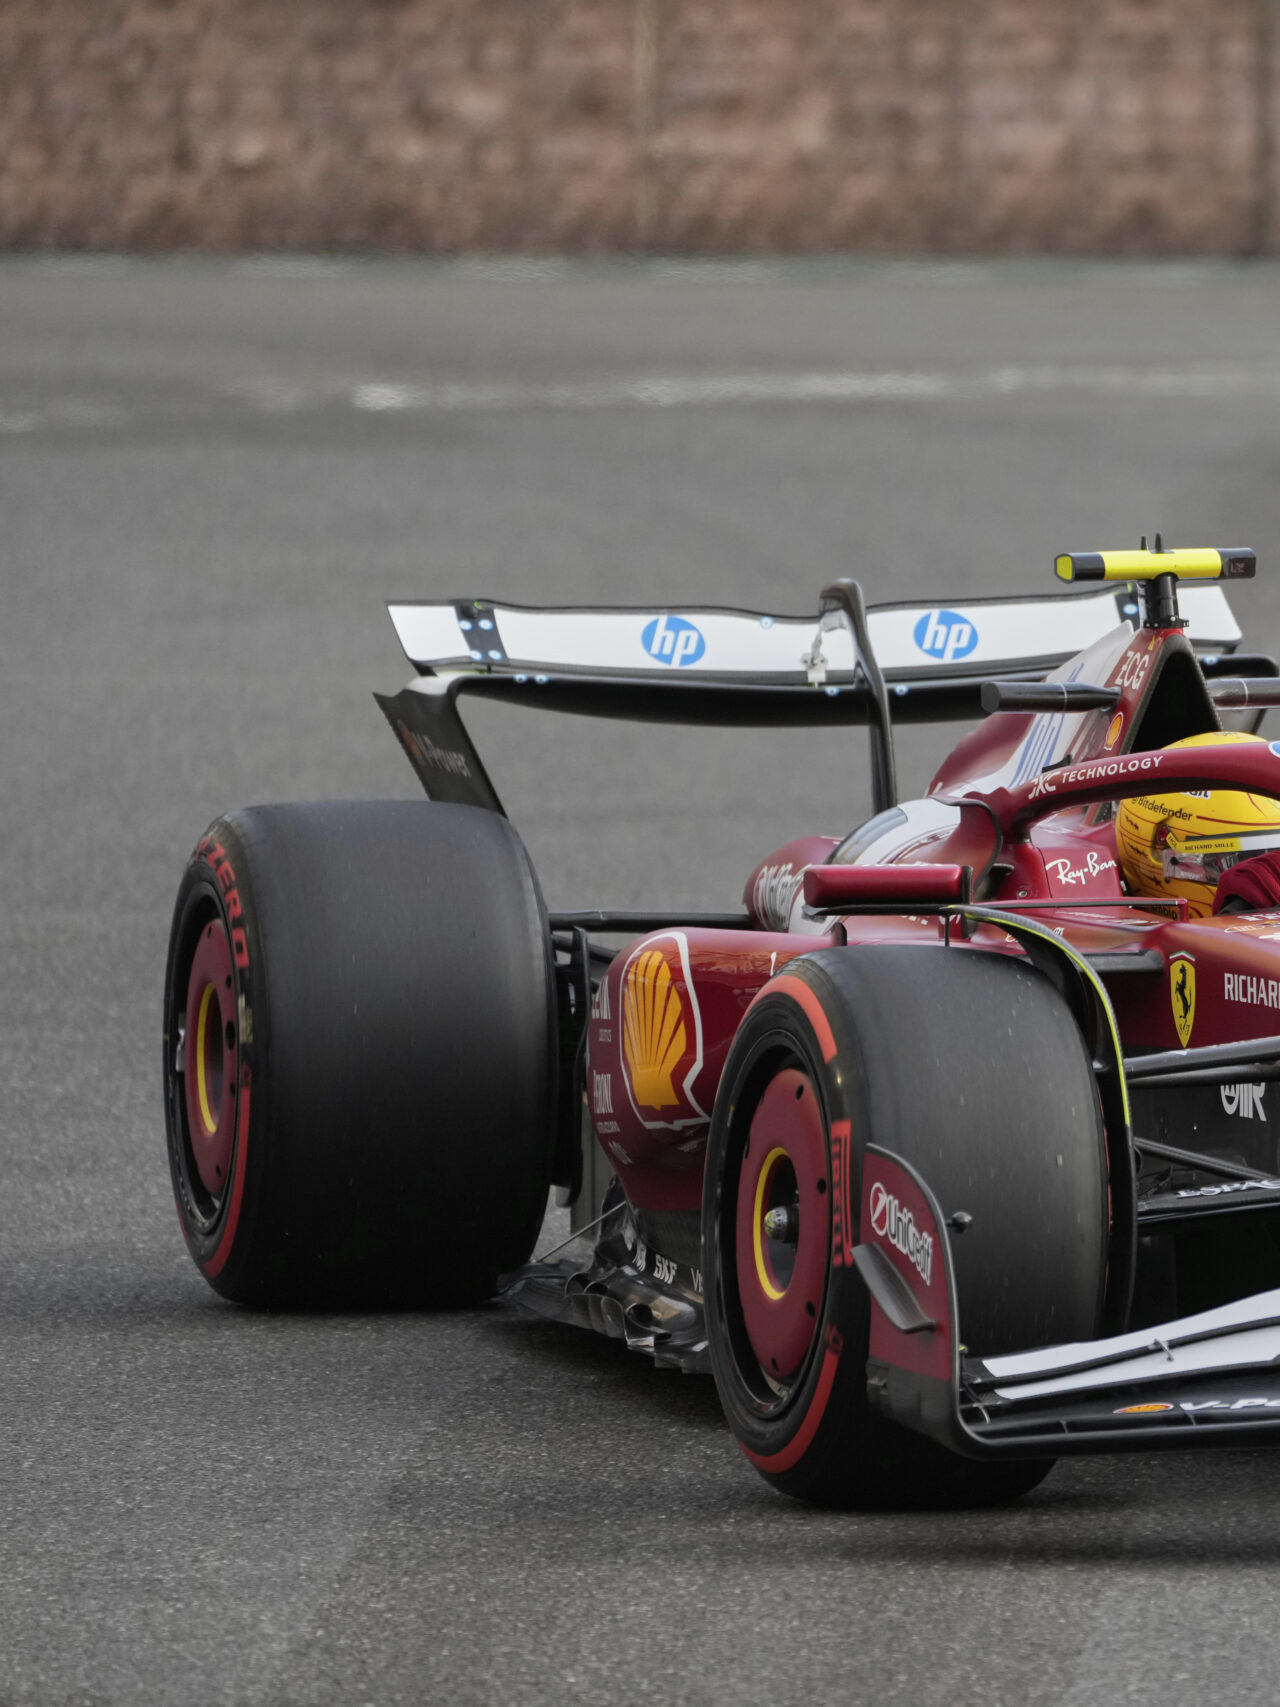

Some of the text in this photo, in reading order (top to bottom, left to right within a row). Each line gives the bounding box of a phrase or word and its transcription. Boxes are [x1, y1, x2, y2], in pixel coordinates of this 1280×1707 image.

[651, 615, 699, 667] hp
[922, 610, 973, 660] hp
[1114, 650, 1150, 690] ZCG
[1062, 756, 1163, 784] TECHNOLOGY
[1138, 796, 1193, 822] Bitdefender
[1045, 851, 1118, 885] Ray-Ban
[207, 841, 249, 968] ZERO
[653, 1253, 678, 1285] SKF
